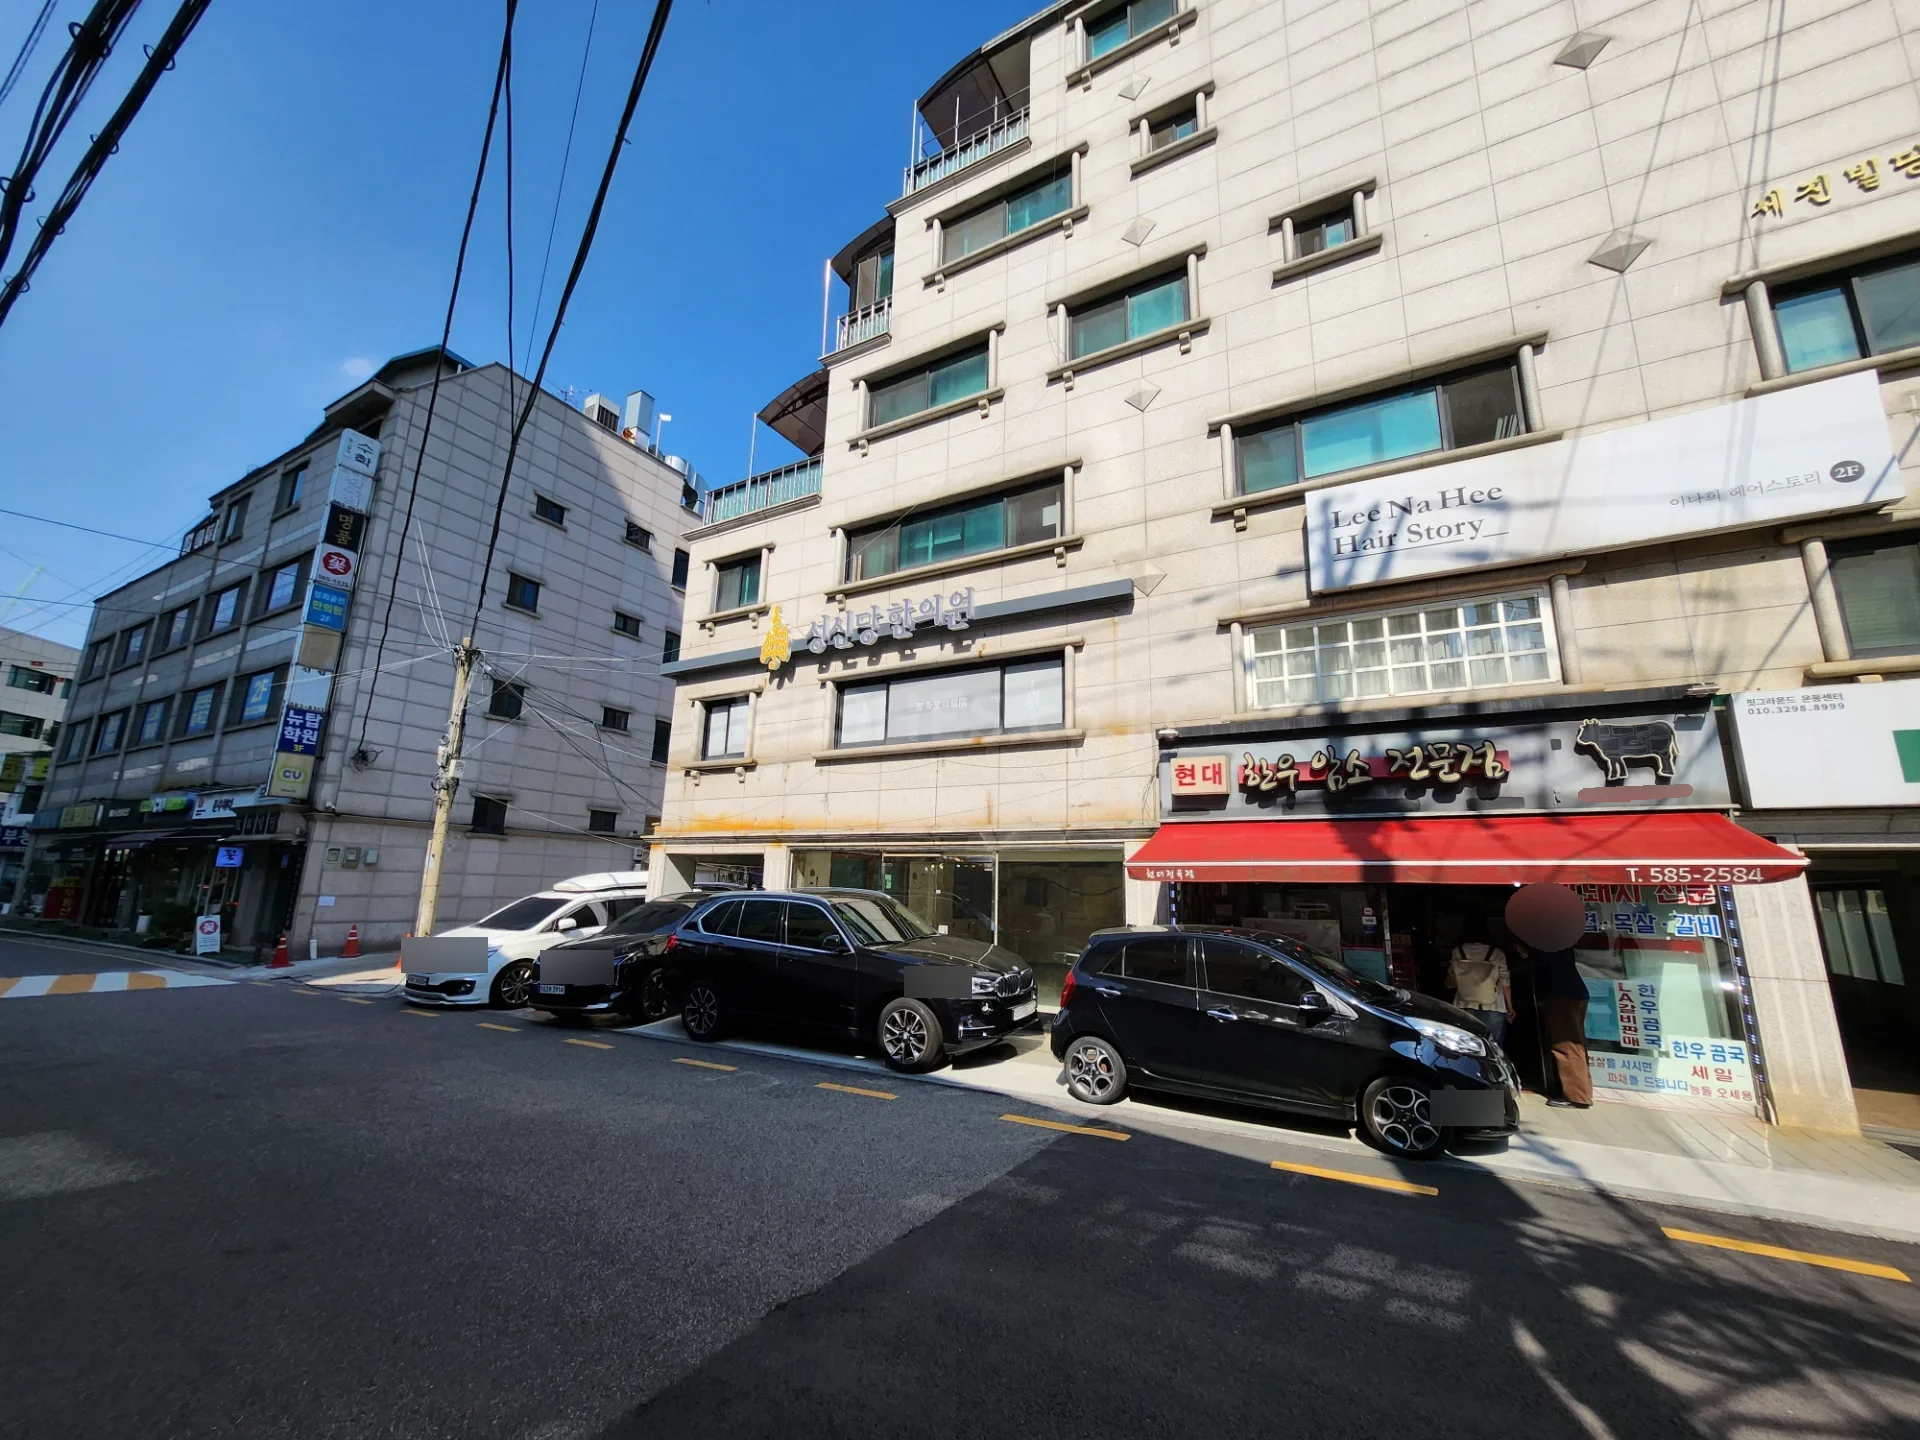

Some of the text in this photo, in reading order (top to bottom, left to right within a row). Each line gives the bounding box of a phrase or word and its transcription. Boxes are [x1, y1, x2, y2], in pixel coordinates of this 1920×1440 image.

[355, 443, 375, 468] 수학
[1670, 464, 1860, 508] 이나희 헤어스토리 2F
[1331, 486, 1503, 530] Lee Na Hee
[1333, 518, 1486, 556] Hair Story
[328, 554, 346, 573] 꽃
[312, 600, 344, 616] 한의원
[320, 614, 331, 622] 2F
[1801, 692, 1844, 704] 운동센터
[1747, 702, 1845, 715] 010.3298.8999
[286, 709, 323, 729] 뉴탑
[283, 726, 319, 745] 학원
[293, 744, 305, 752] 3F
[282, 769, 302, 780] CU
[1174, 763, 1222, 787] 현대
[1243, 738, 1506, 794] 한우 암소 전문점
[1146, 867, 1195, 880] 현대정육점
[1625, 866, 1764, 883] T. 585-2584
[1654, 884, 1716, 906] 전문
[1614, 912, 1657, 935] 목살
[1674, 913, 1722, 938] 갈비
[1617, 982, 1640, 1047] LA갈비판매
[1671, 1040, 1746, 1065] 한우 곰국
[1621, 1059, 1653, 1073] 사시면
[1643, 1076, 1689, 1092] 드립니다
